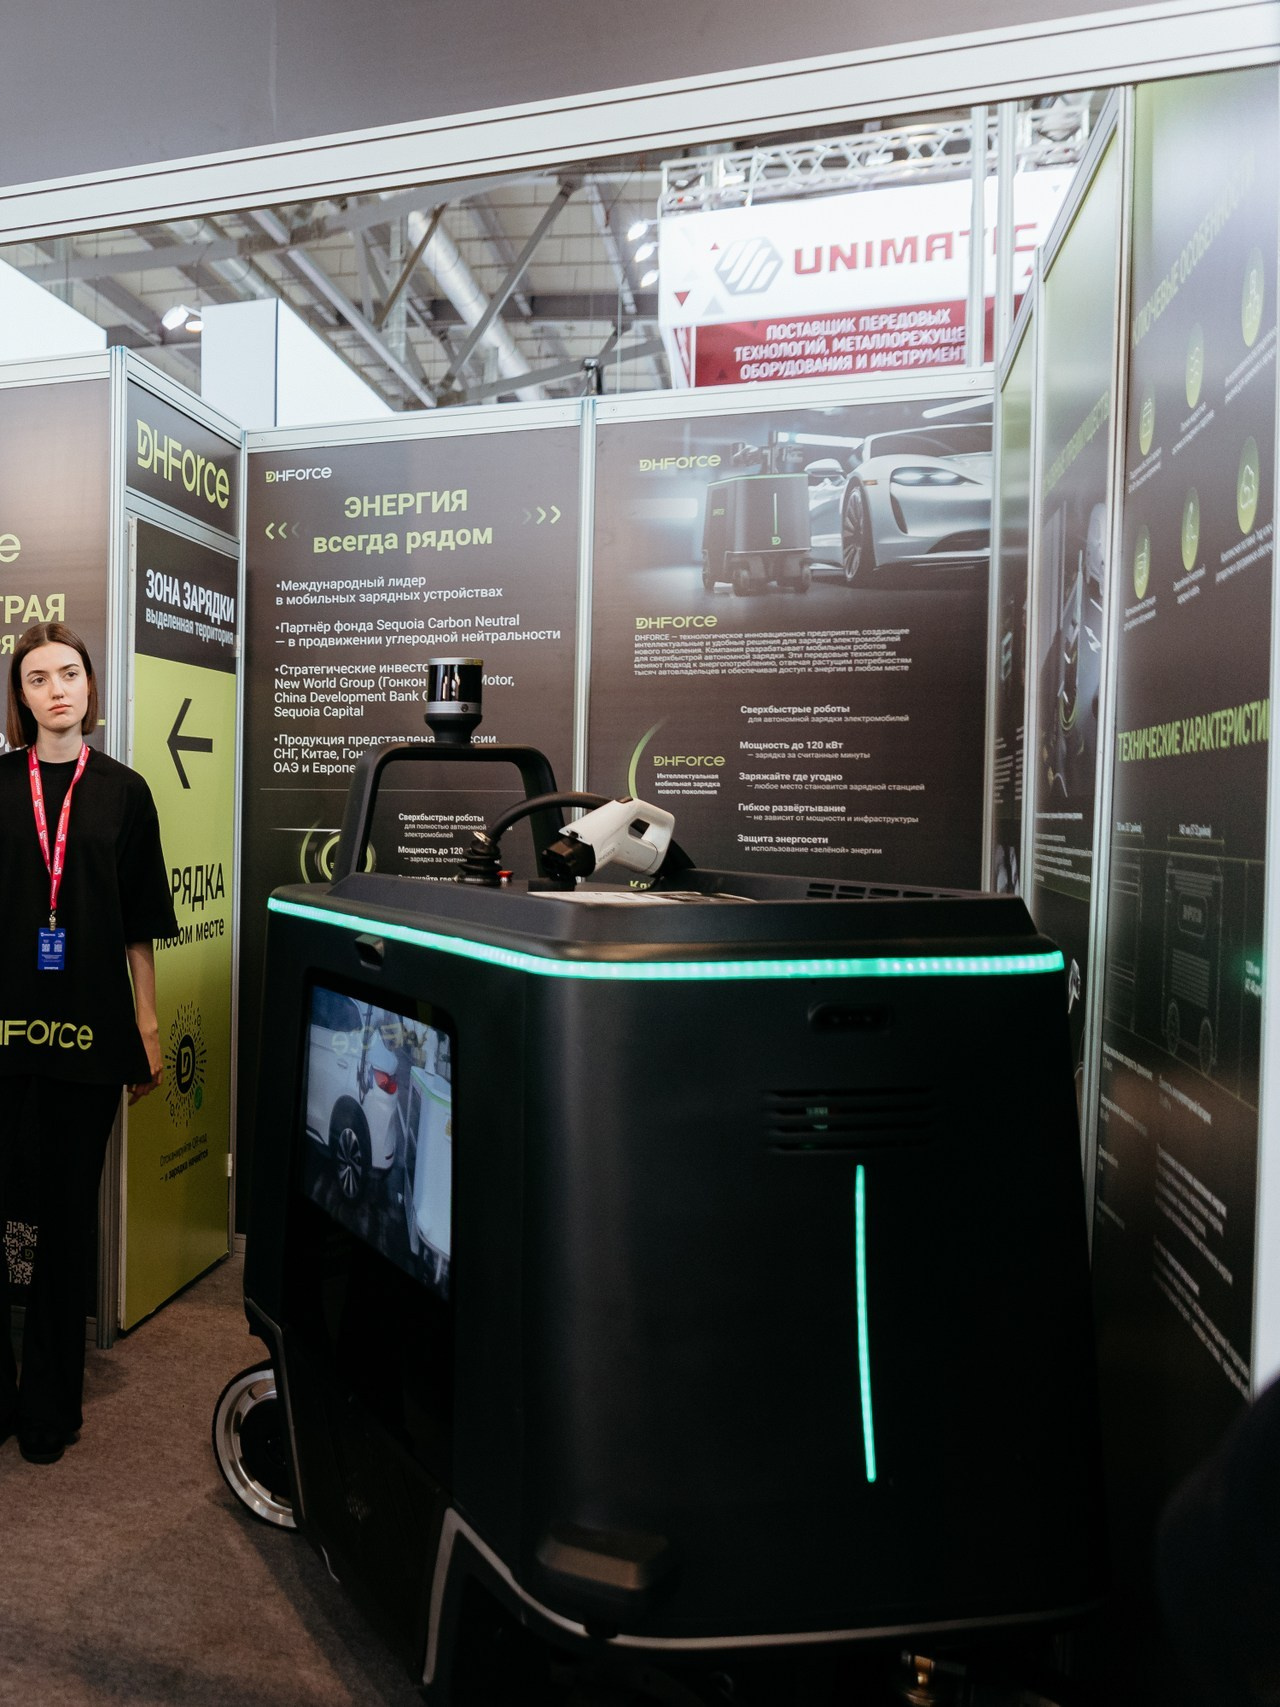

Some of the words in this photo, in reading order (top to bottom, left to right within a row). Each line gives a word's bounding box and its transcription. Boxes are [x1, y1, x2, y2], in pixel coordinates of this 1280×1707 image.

[766, 317, 856, 341] ПОСТАВЩИК
[859, 308, 951, 332] ПЕРЕДОВЫХ
[733, 337, 830, 362] ТЕХНОЛОГИЙ,
[832, 325, 966, 351] МЕТАЛЛОРЕЖУЩЕ
[740, 354, 853, 380] ОБОРУДОВАНИЯ
[856, 353, 868, 369] И
[870, 345, 966, 368] ИНСТРУМЕНТ
[136, 418, 230, 510] DHForce
[639, 454, 721, 472] DHForce
[265, 466, 332, 483] DHForce
[344, 488, 468, 519] ЭНЕРГИЯ
[313, 532, 398, 555] всегда
[406, 527, 493, 554] рядом
[281, 575, 385, 593] Международный
[388, 575, 426, 589] лидер
[145, 568, 181, 608] ЗОНА
[183, 581, 235, 626] ЗАРЯДКИ
[286, 592, 356, 605] мобильных
[359, 591, 420, 606] зарядных
[423, 585, 503, 602] устройствах
[145, 607, 194, 635] выделенная
[195, 621, 234, 647] территория
[281, 620, 331, 637] Партнёр
[333, 619, 373, 637] фонда
[376, 617, 424, 635] Sequoia
[428, 616, 471, 630] Carbon
[475, 614, 520, 628] Neutral
[635, 615, 718, 630] DHForce
[288, 639, 295, 647] в
[298, 635, 382, 651] продвижении
[385, 631, 458, 648] углеродной
[462, 629, 561, 645] нейтральности
[279, 663, 376, 677] Стратегические
[379, 662, 429, 674] инвесто
[274, 678, 300, 690] New
[303, 677, 337, 689] World
[339, 677, 375, 691] Group
[378, 676, 427, 691] (Гонкон
[274, 691, 307, 703] China
[310, 691, 386, 706] Development
[389, 690, 419, 702] Bank
[274, 706, 320, 719] Sequoia
[323, 705, 364, 719] Capital
[740, 705, 812, 715] Сверхбыстрые
[813, 705, 850, 715] роботы
[763, 715, 809, 723] автономной
[810, 715, 843, 724] зарядки
[844, 715, 909, 723] электромобилей
[1117, 719, 1181, 763] ТЕХНИЧЕСКИЕ
[1182, 697, 1270, 754] ХАРАКТЕРИСТИ
[279, 734, 345, 748] Продукция
[739, 741, 789, 750] Мощность
[791, 742, 804, 751] до
[806, 741, 823, 750] 120
[273, 748, 298, 761] СНГ,
[301, 748, 339, 761] Китае,
[653, 755, 726, 767] DHForce
[755, 752, 786, 760] зарядка
[840, 752, 871, 760] минуты
[273, 762, 298, 773] ОАЭ
[302, 765, 309, 773] и
[313, 762, 357, 775] Европе
[738, 771, 790, 781] Заряжайте
[792, 773, 808, 782] где
[810, 773, 843, 782] угодно
[849, 783, 887, 791] зарядной
[888, 783, 925, 792] станцией
[738, 803, 770, 812] Гибкое
[772, 803, 846, 813] развёртывание
[398, 813, 454, 824] Сверхбыстрые
[455, 814, 484, 824] роботы
[853, 815, 919, 824] инфраструктуры
[450, 823, 487, 831] автономной
[404, 831, 454, 839] электромобилей
[737, 834, 773, 844] Защита
[775, 835, 829, 845] энергосети
[398, 846, 437, 856] Мощность
[438, 847, 448, 856] до
[450, 847, 464, 855] 120
[751, 845, 809, 853] использование
[850, 847, 883, 855] энергии
[172, 862, 225, 912] РЯДКА
[195, 917, 225, 942] месте
